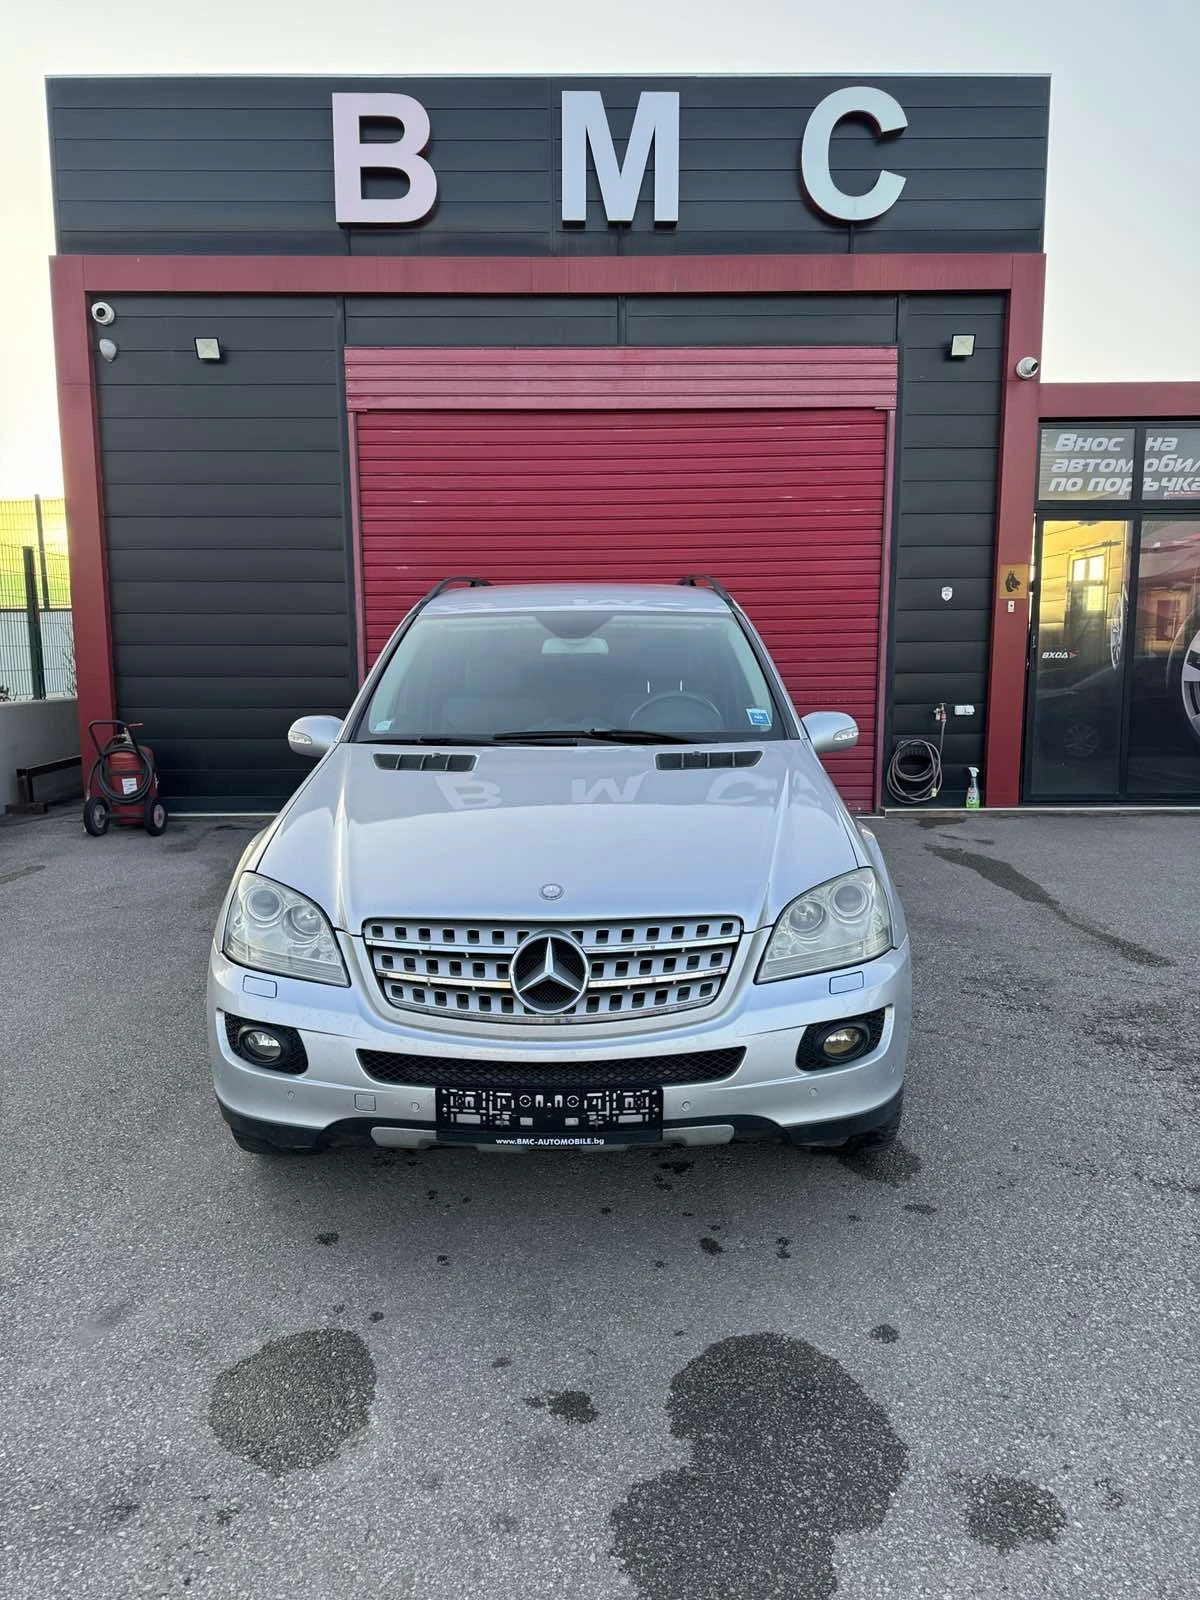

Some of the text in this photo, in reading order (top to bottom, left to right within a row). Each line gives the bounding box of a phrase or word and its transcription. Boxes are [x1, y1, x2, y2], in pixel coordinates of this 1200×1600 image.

[1055, 433, 1179, 452] Внос на
[1048, 477, 1083, 492] по
[495, 1137, 605, 1146] www.BMC-AUTOMOBILE.bg
